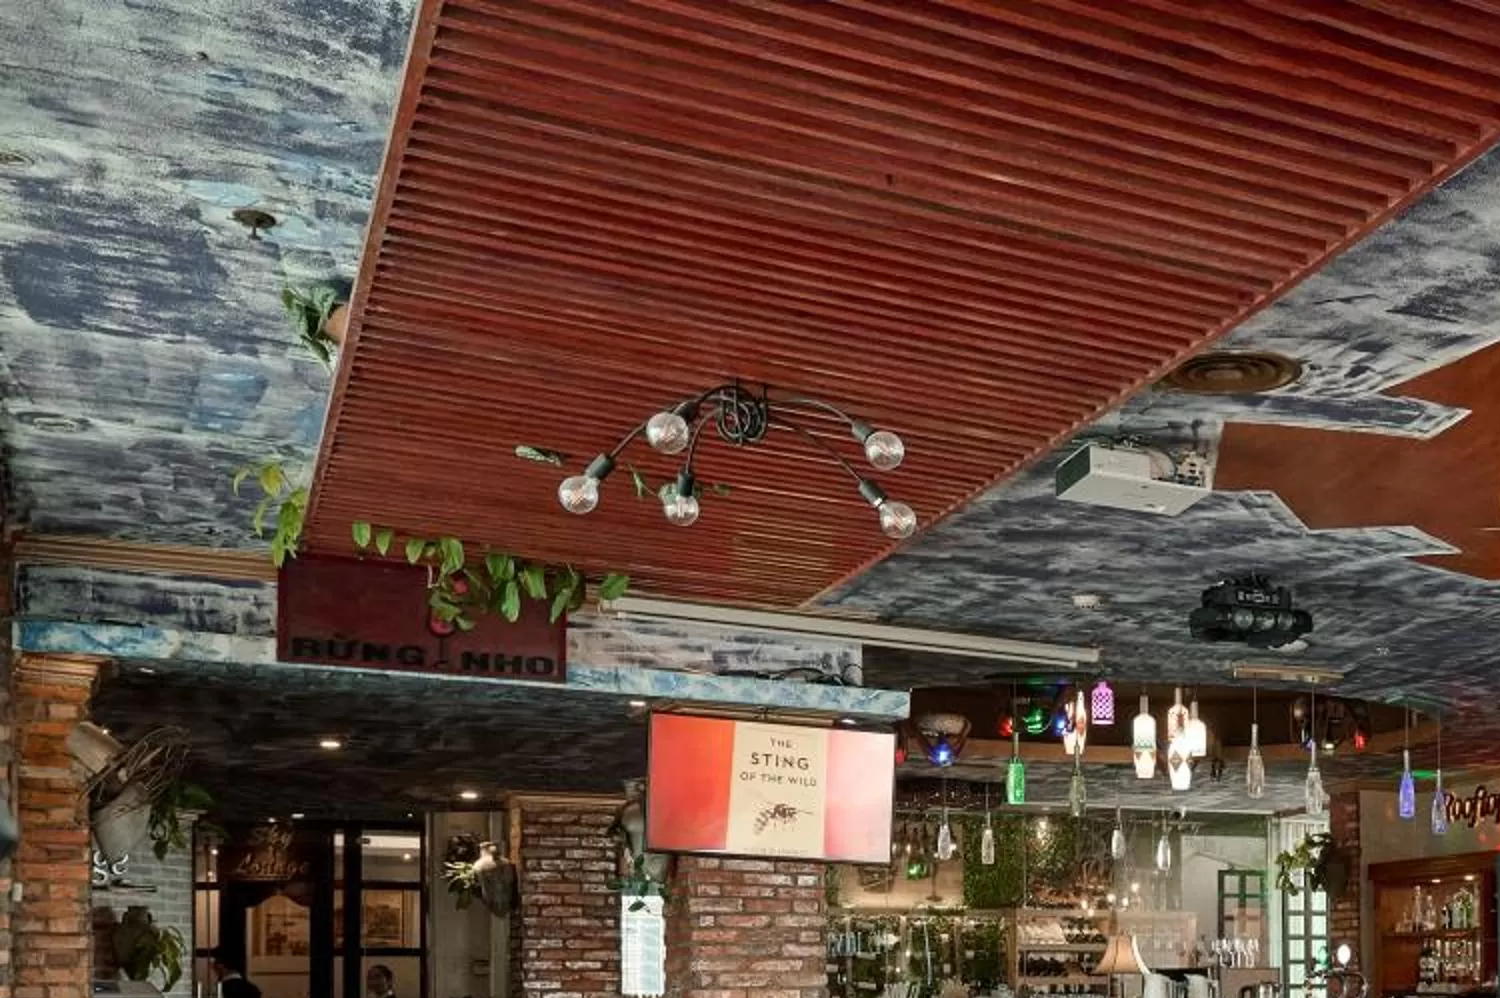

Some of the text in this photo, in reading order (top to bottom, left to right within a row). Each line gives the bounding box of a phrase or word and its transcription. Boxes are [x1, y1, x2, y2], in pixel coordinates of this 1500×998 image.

[461, 651, 556, 675] NHO
[769, 736, 793, 749] THE
[750, 751, 810, 771] STING
[739, 771, 817, 788] OF THE WILD
